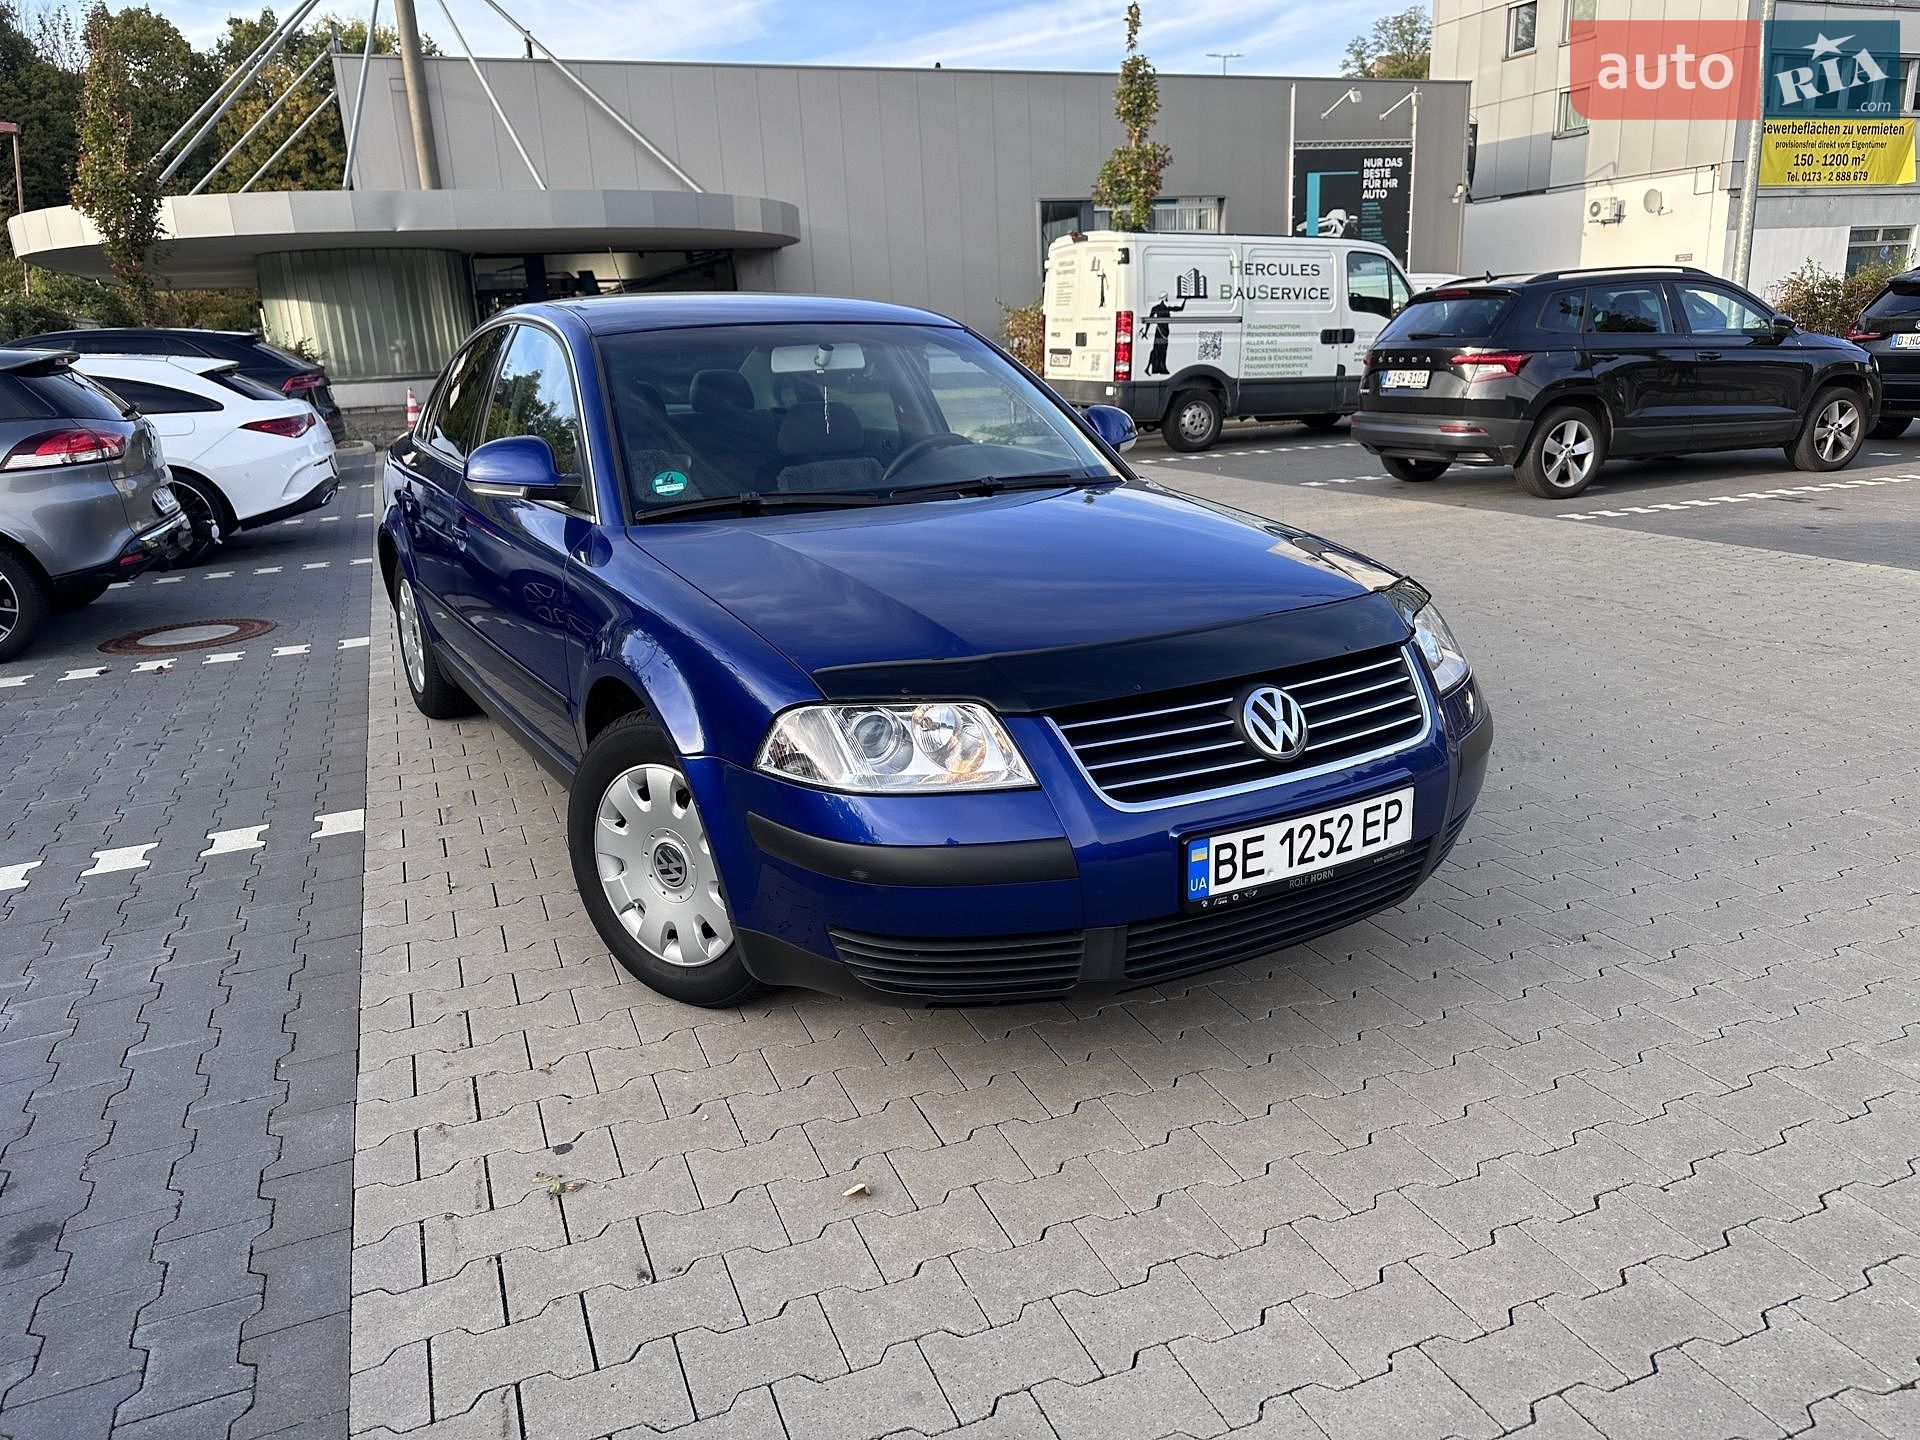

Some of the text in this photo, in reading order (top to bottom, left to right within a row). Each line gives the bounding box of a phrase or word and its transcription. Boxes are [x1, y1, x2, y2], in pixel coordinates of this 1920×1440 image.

[1843, 125, 1854, 135] zu
[1857, 122, 1905, 136] vermieten
[1775, 140, 1817, 150] provisionsfrei
[1817, 140, 1837, 149] direkt
[1363, 158, 1403, 168] NUR DAS
[1793, 153, 1814, 167] 150
[1821, 153, 1849, 167] 1200
[1363, 168, 1391, 178] BESTE
[1787, 171, 1800, 182] Tel.
[1801, 171, 1822, 182] 0173
[1828, 171, 1834, 182] 2
[1835, 171, 1852, 182] 888
[1853, 171, 1868, 182] 679
[1362, 178, 1398, 188] FÜR IHR
[1362, 189, 1388, 199] AUTO
[1213, 798, 1403, 887] BE 1252 EP
[1190, 876, 1208, 892] UA
[1289, 869, 1334, 889] ROLF HORN
